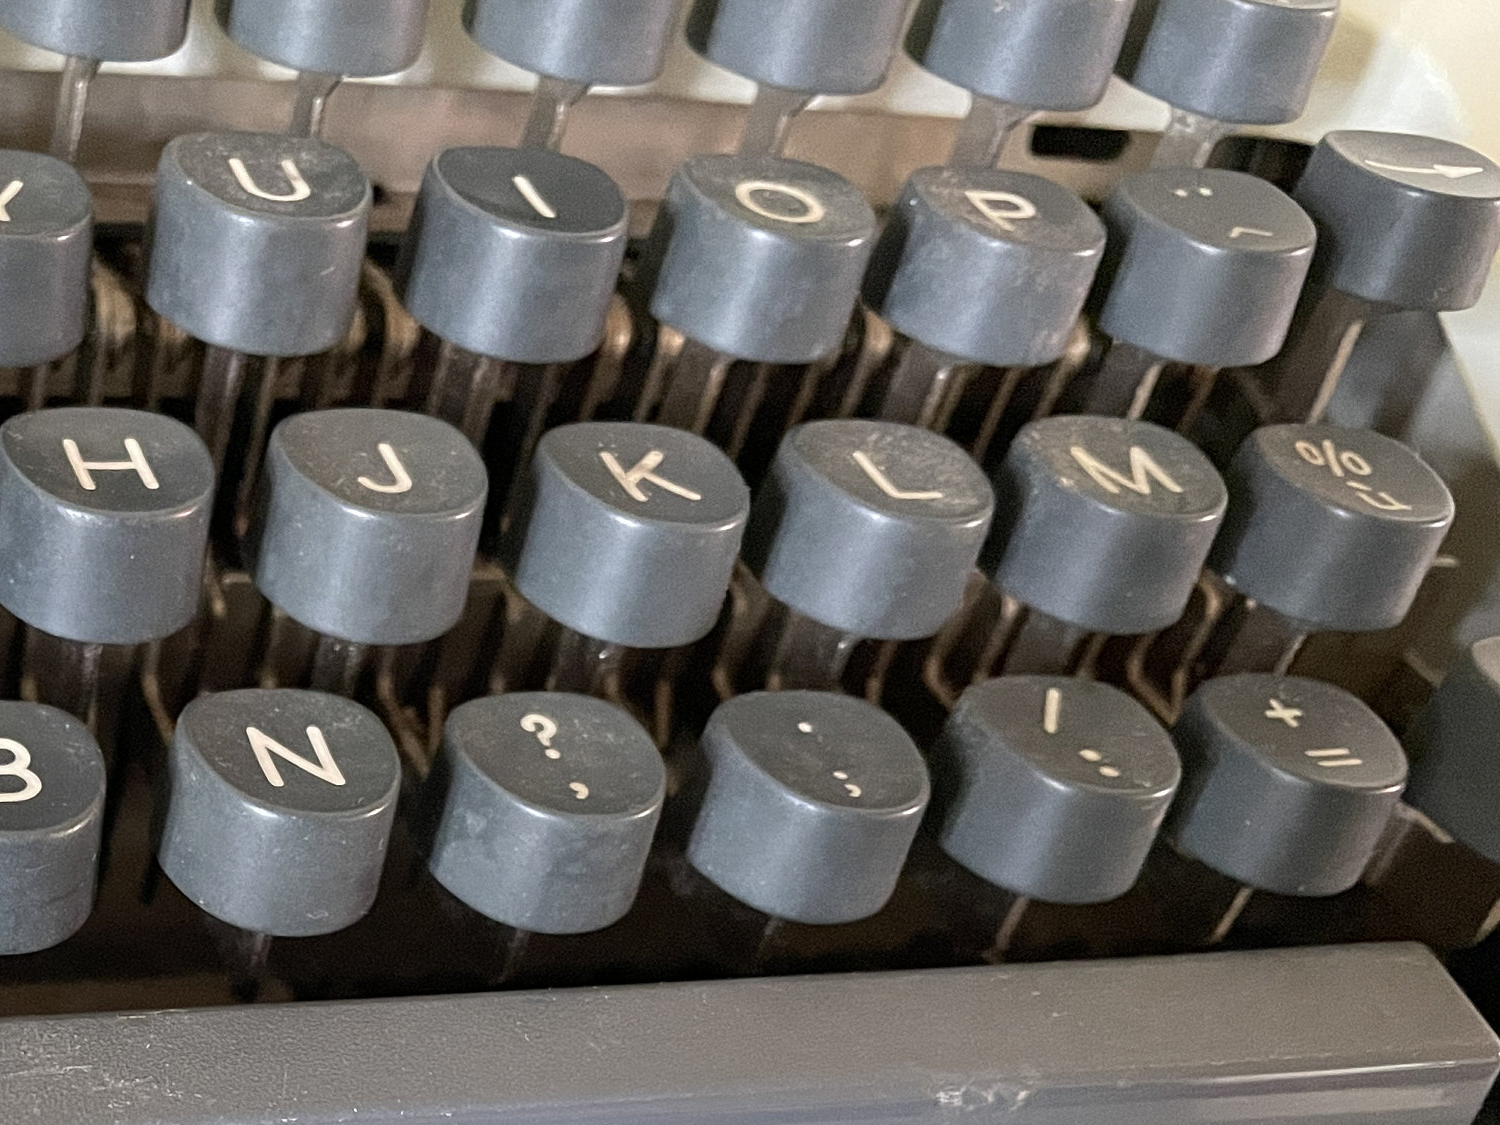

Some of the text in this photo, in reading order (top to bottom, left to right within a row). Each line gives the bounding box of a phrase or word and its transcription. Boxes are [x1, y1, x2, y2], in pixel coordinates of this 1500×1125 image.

[228, 157, 311, 202] U
[511, 174, 556, 218] I
[734, 180, 825, 224] O
[963, 189, 1037, 231] P
[62, 437, 160, 491] H
[357, 442, 413, 494] J
[599, 450, 702, 502] K
[852, 450, 946, 500] L
[1069, 445, 1184, 495] M
[1295, 439, 1373, 478] %
[1264, 698, 1303, 728] +
[245, 725, 346, 787] N
[520, 713, 561, 760] ?
[1304, 748, 1364, 767] =
